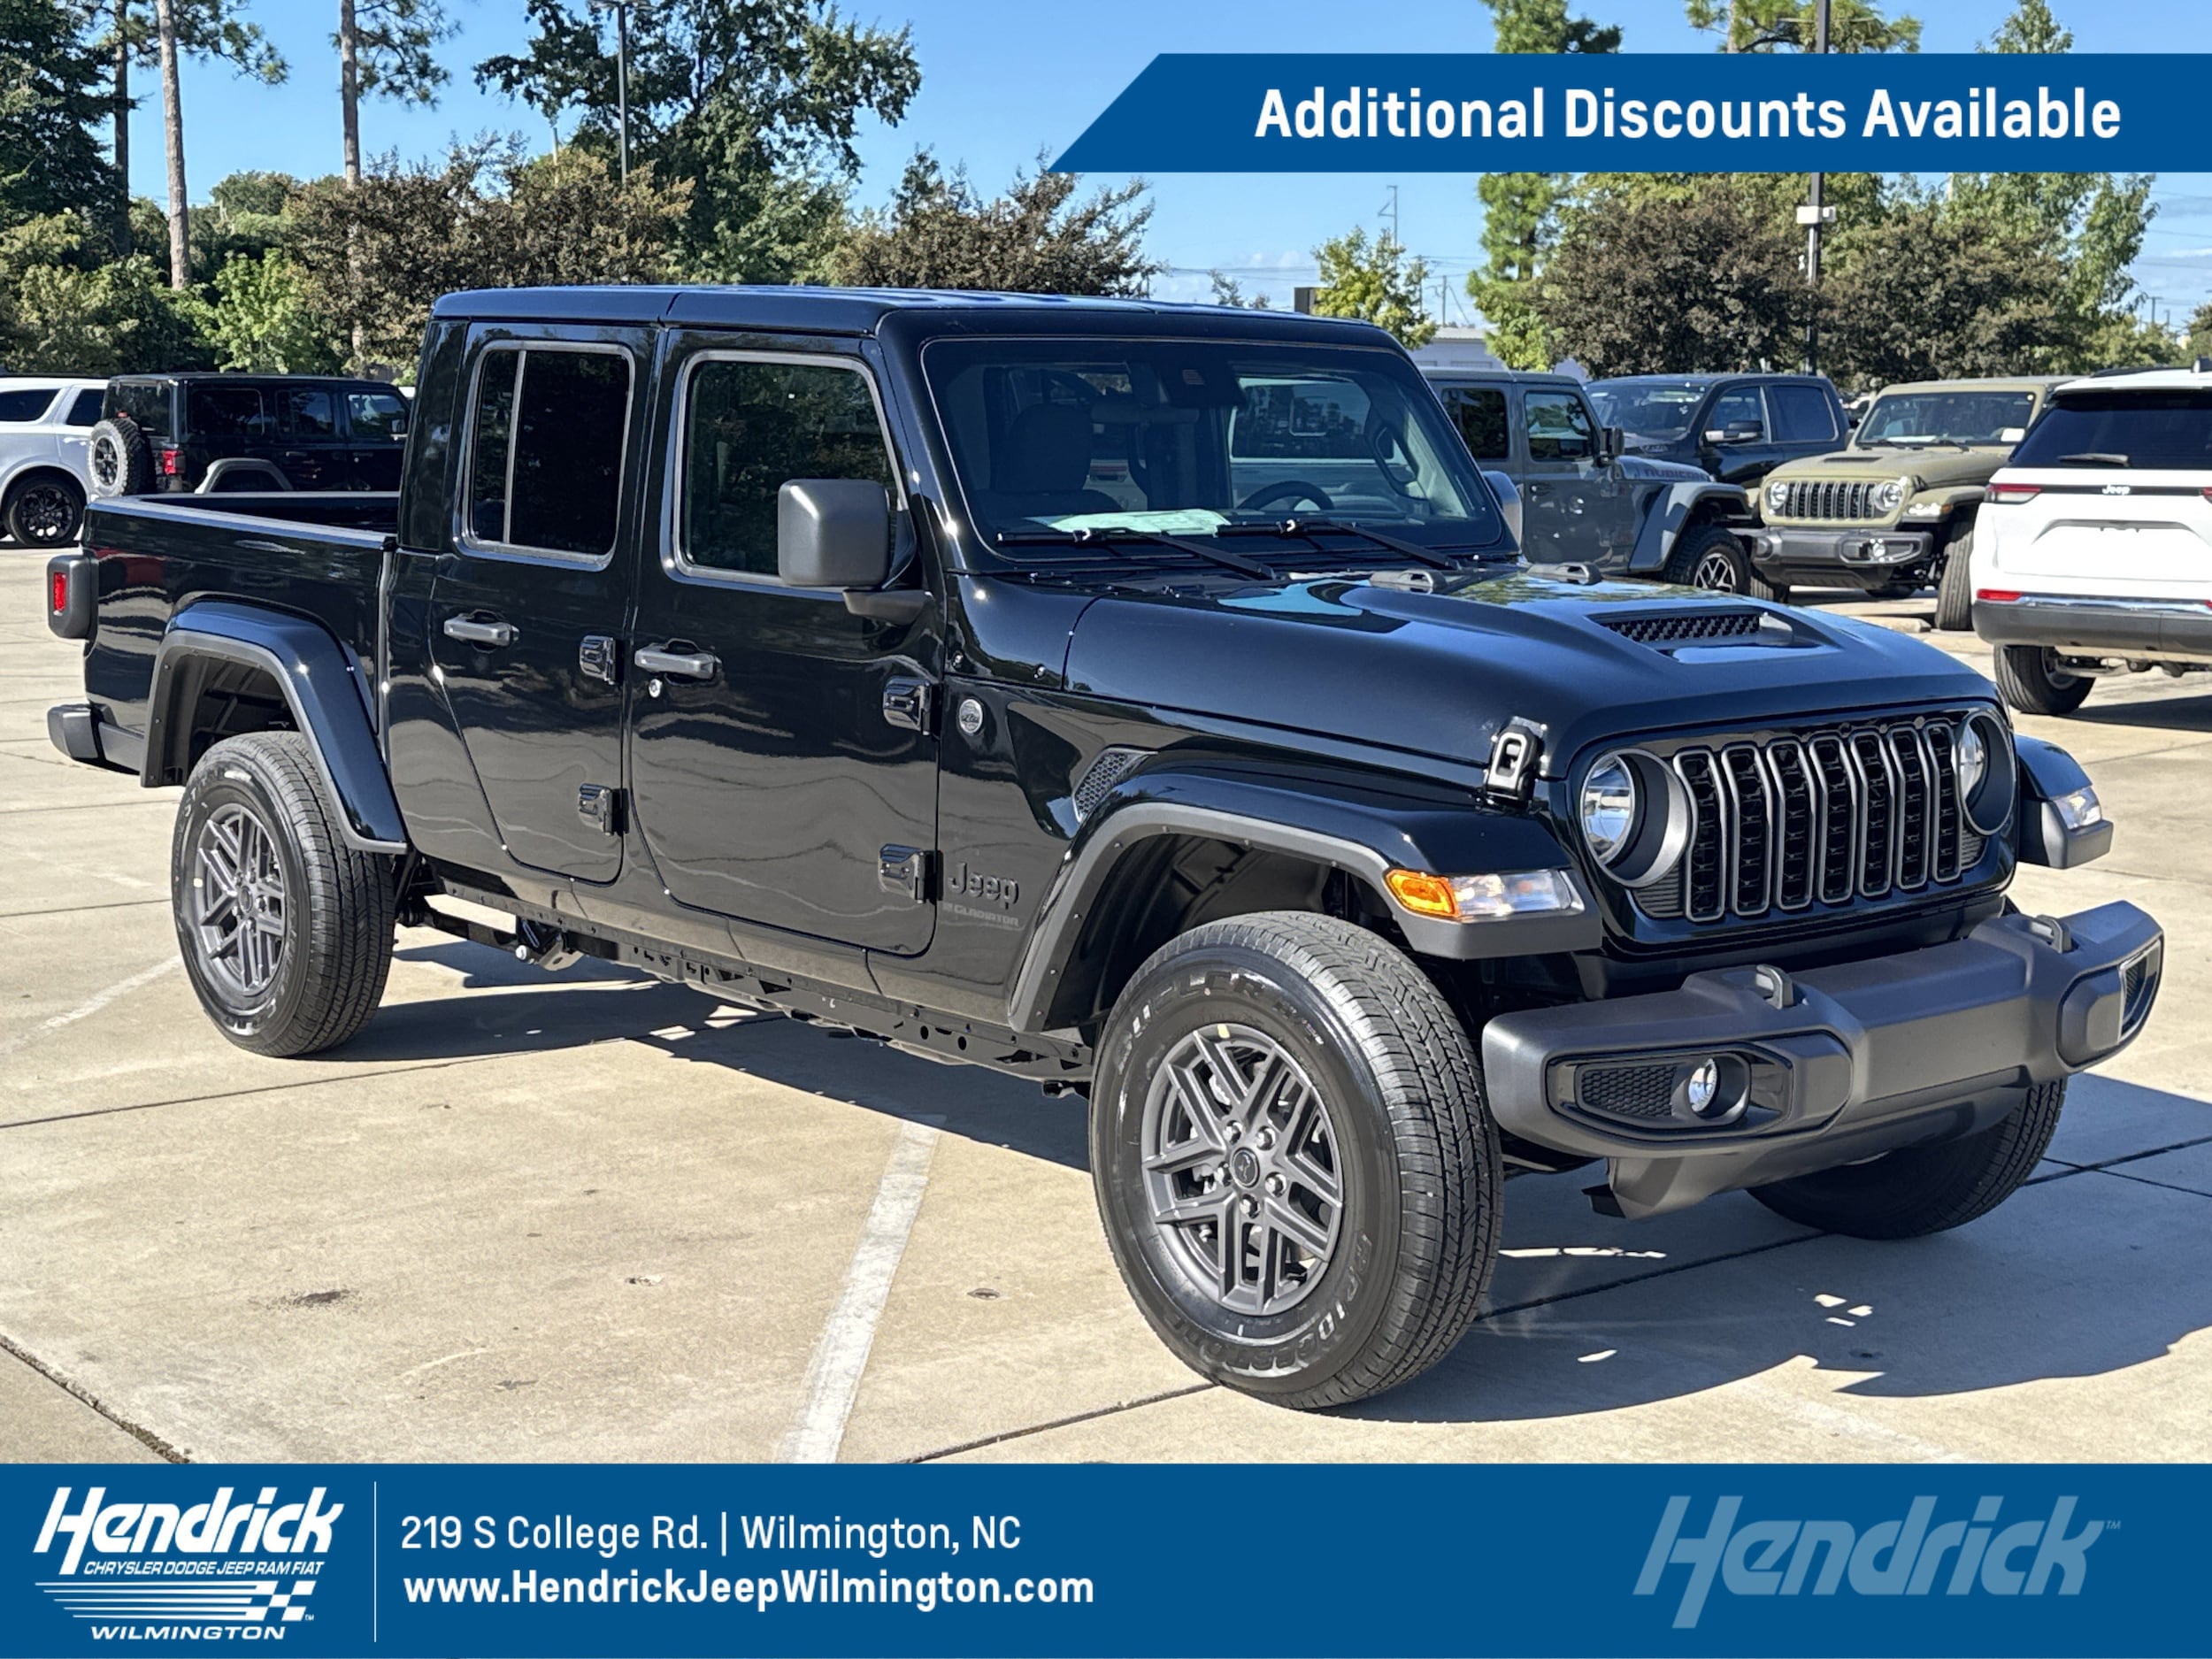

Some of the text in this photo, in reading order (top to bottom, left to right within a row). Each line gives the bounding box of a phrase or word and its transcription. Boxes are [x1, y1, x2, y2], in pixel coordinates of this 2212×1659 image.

[2101, 484, 2131, 496] Jeep
[948, 863, 1019, 910] Jeep
[953, 903, 1020, 927] GLADIATOR
